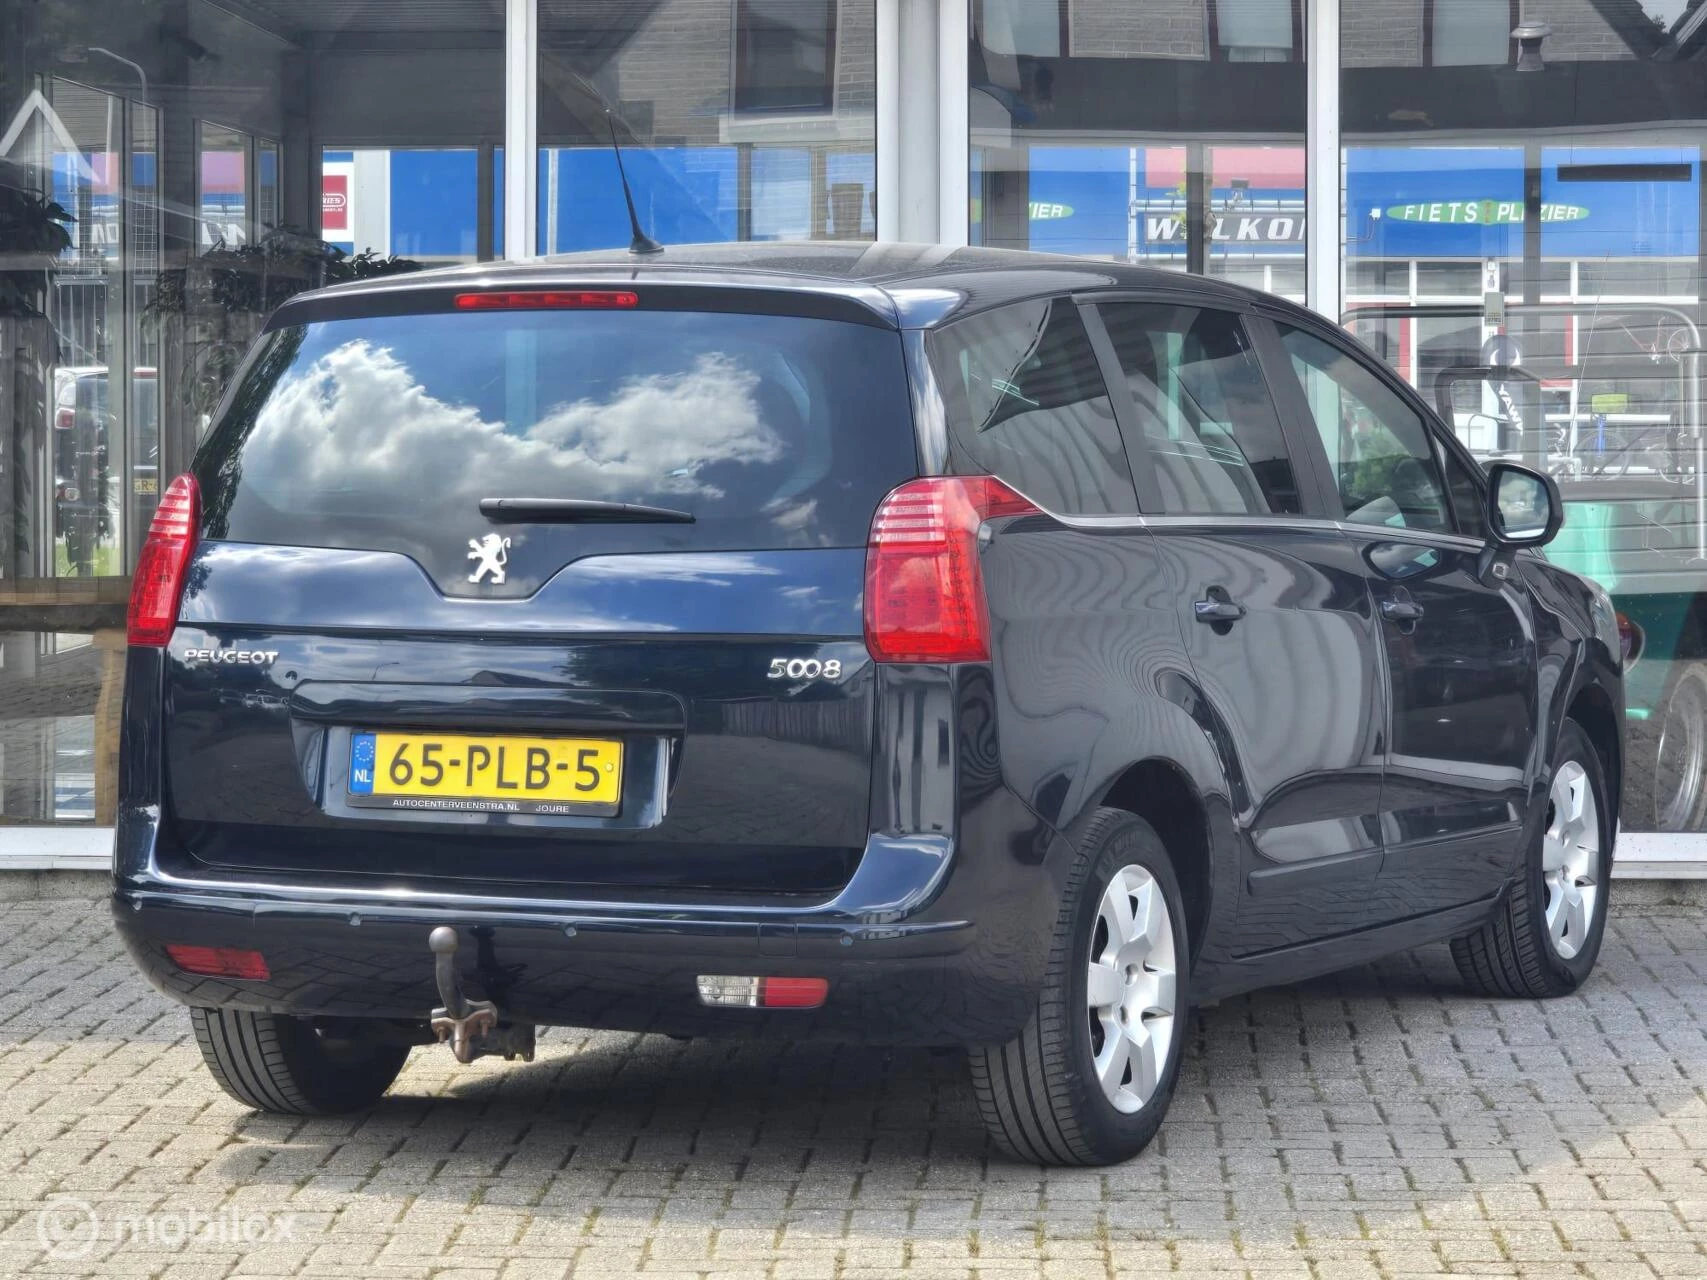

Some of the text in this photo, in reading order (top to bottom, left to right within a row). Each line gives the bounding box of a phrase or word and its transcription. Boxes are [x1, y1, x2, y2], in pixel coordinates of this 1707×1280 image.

[1404, 202, 1579, 222] FIETS PLZIER
[1147, 217, 1306, 241] WLKO
[183, 649, 280, 665] PEUGEOT
[767, 658, 842, 678] 5008
[354, 769, 372, 784] NL
[389, 743, 601, 792] 65-PLB-5
[392, 799, 570, 814] AUTOCENTERVEENSTRA.NL JOURE
